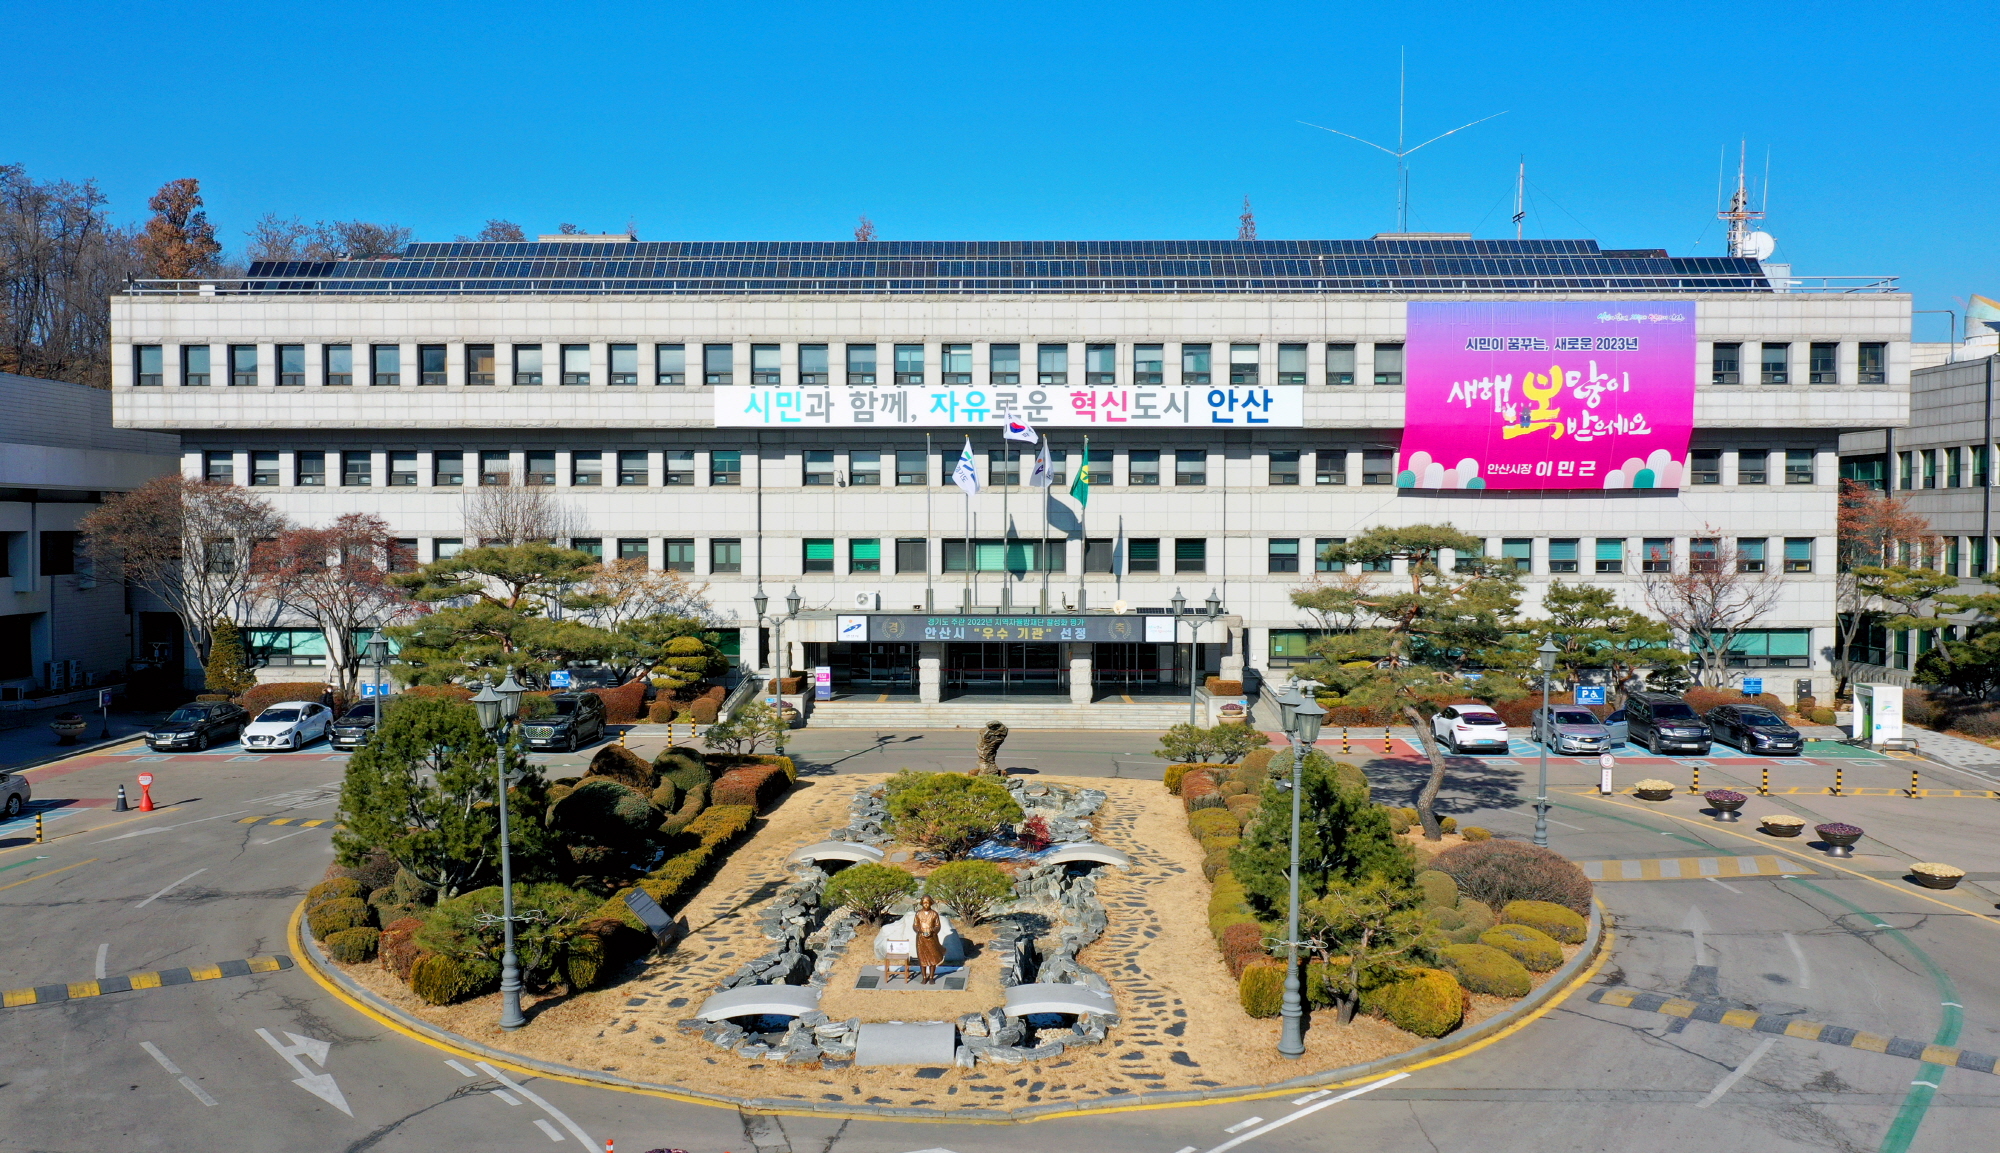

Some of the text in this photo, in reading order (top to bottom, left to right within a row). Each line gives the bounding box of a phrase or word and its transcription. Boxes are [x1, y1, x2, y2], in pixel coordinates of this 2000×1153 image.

[1465, 337, 1638, 351] 시민이 꿈꾸는, 새로운 2023년
[744, 389, 1273, 423] 시민과 함께, 자유로운 혁신도시 안산
[1447, 360, 1630, 440] 새해 복 많이
[1567, 410, 1651, 441] 받으세요
[1487, 463, 1532, 475] 안산시장
[927, 617, 949, 626] 경기도
[967, 618, 993, 626] 2022년
[924, 627, 965, 640] 안산시
[1060, 627, 1086, 640] 선정
[367, 687, 373, 695] P
[1582, 690, 1589, 698] P
